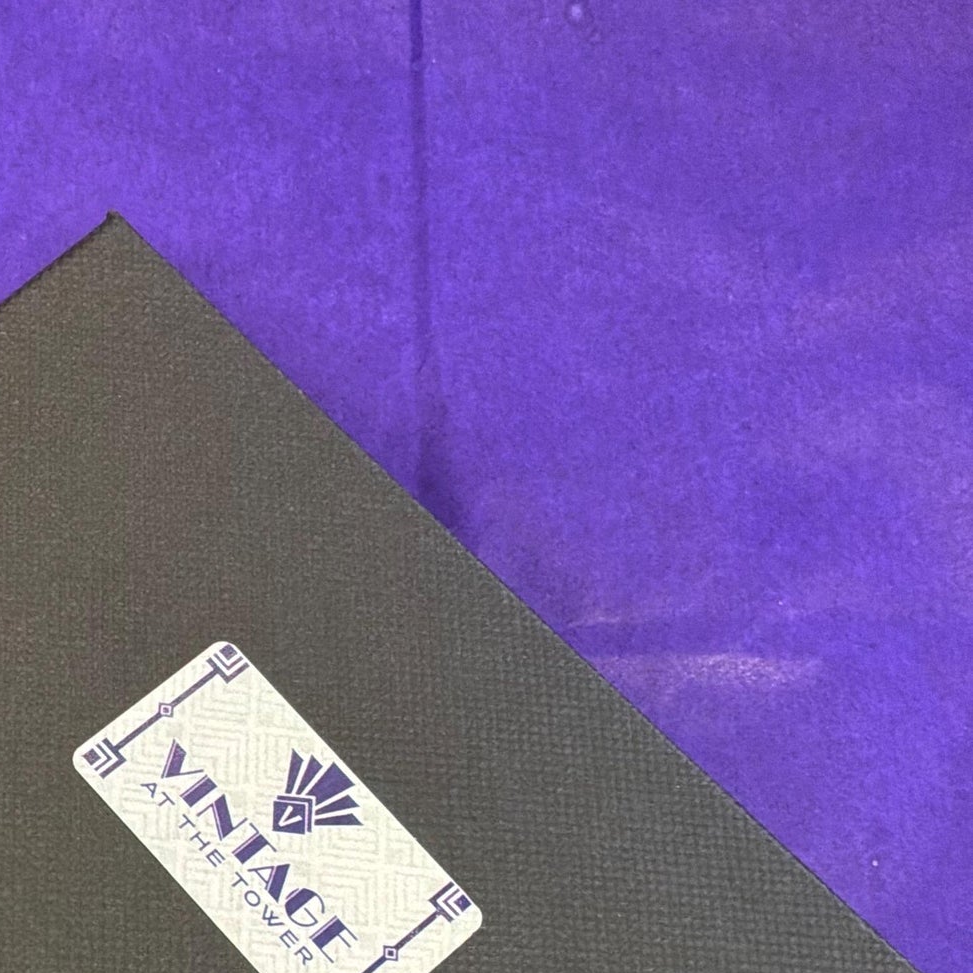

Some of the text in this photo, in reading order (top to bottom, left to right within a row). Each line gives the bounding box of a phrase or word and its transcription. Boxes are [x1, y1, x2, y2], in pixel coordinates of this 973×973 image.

[140, 782, 314, 965] AT THE TOWER
[161, 738, 358, 964] VINTAGE
